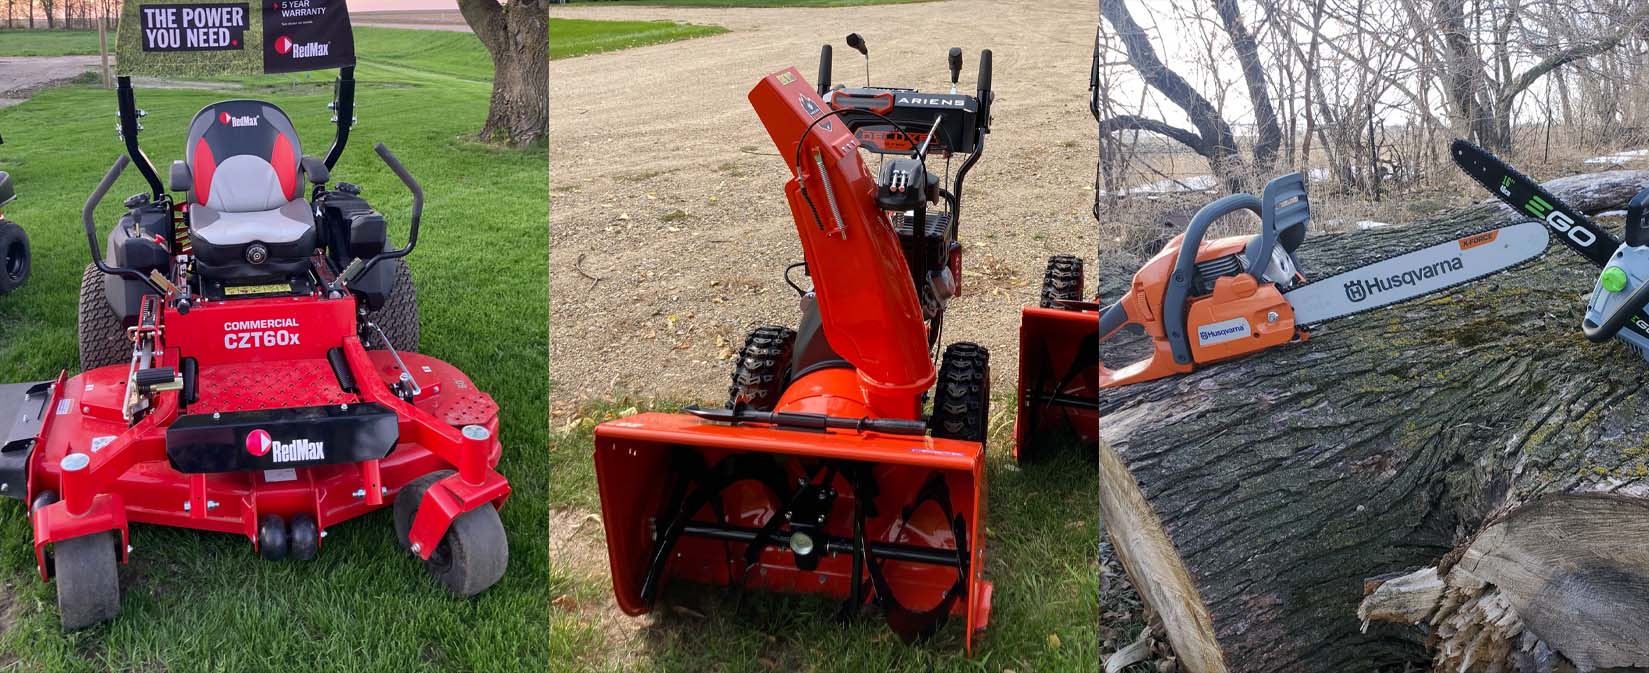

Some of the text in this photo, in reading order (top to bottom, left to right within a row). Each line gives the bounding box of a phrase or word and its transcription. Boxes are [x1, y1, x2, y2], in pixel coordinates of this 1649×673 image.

[281, 0, 310, 9] 5 YEAR
[282, 7, 326, 17] WARRANTY
[143, 7, 244, 28] THE POWER
[145, 28, 238, 48] YOU NEED.
[292, 41, 329, 59] RedMax
[897, 97, 965, 107] ARIENS
[231, 115, 259, 127] RedMax
[1525, 196, 1596, 247] EGO
[1365, 257, 1463, 295] Husqvarna
[224, 318, 299, 331] COMMERCIAL
[1208, 326, 1244, 337] Husqvarna
[224, 330, 301, 350] CZT60x
[271, 438, 325, 463] RedMax
